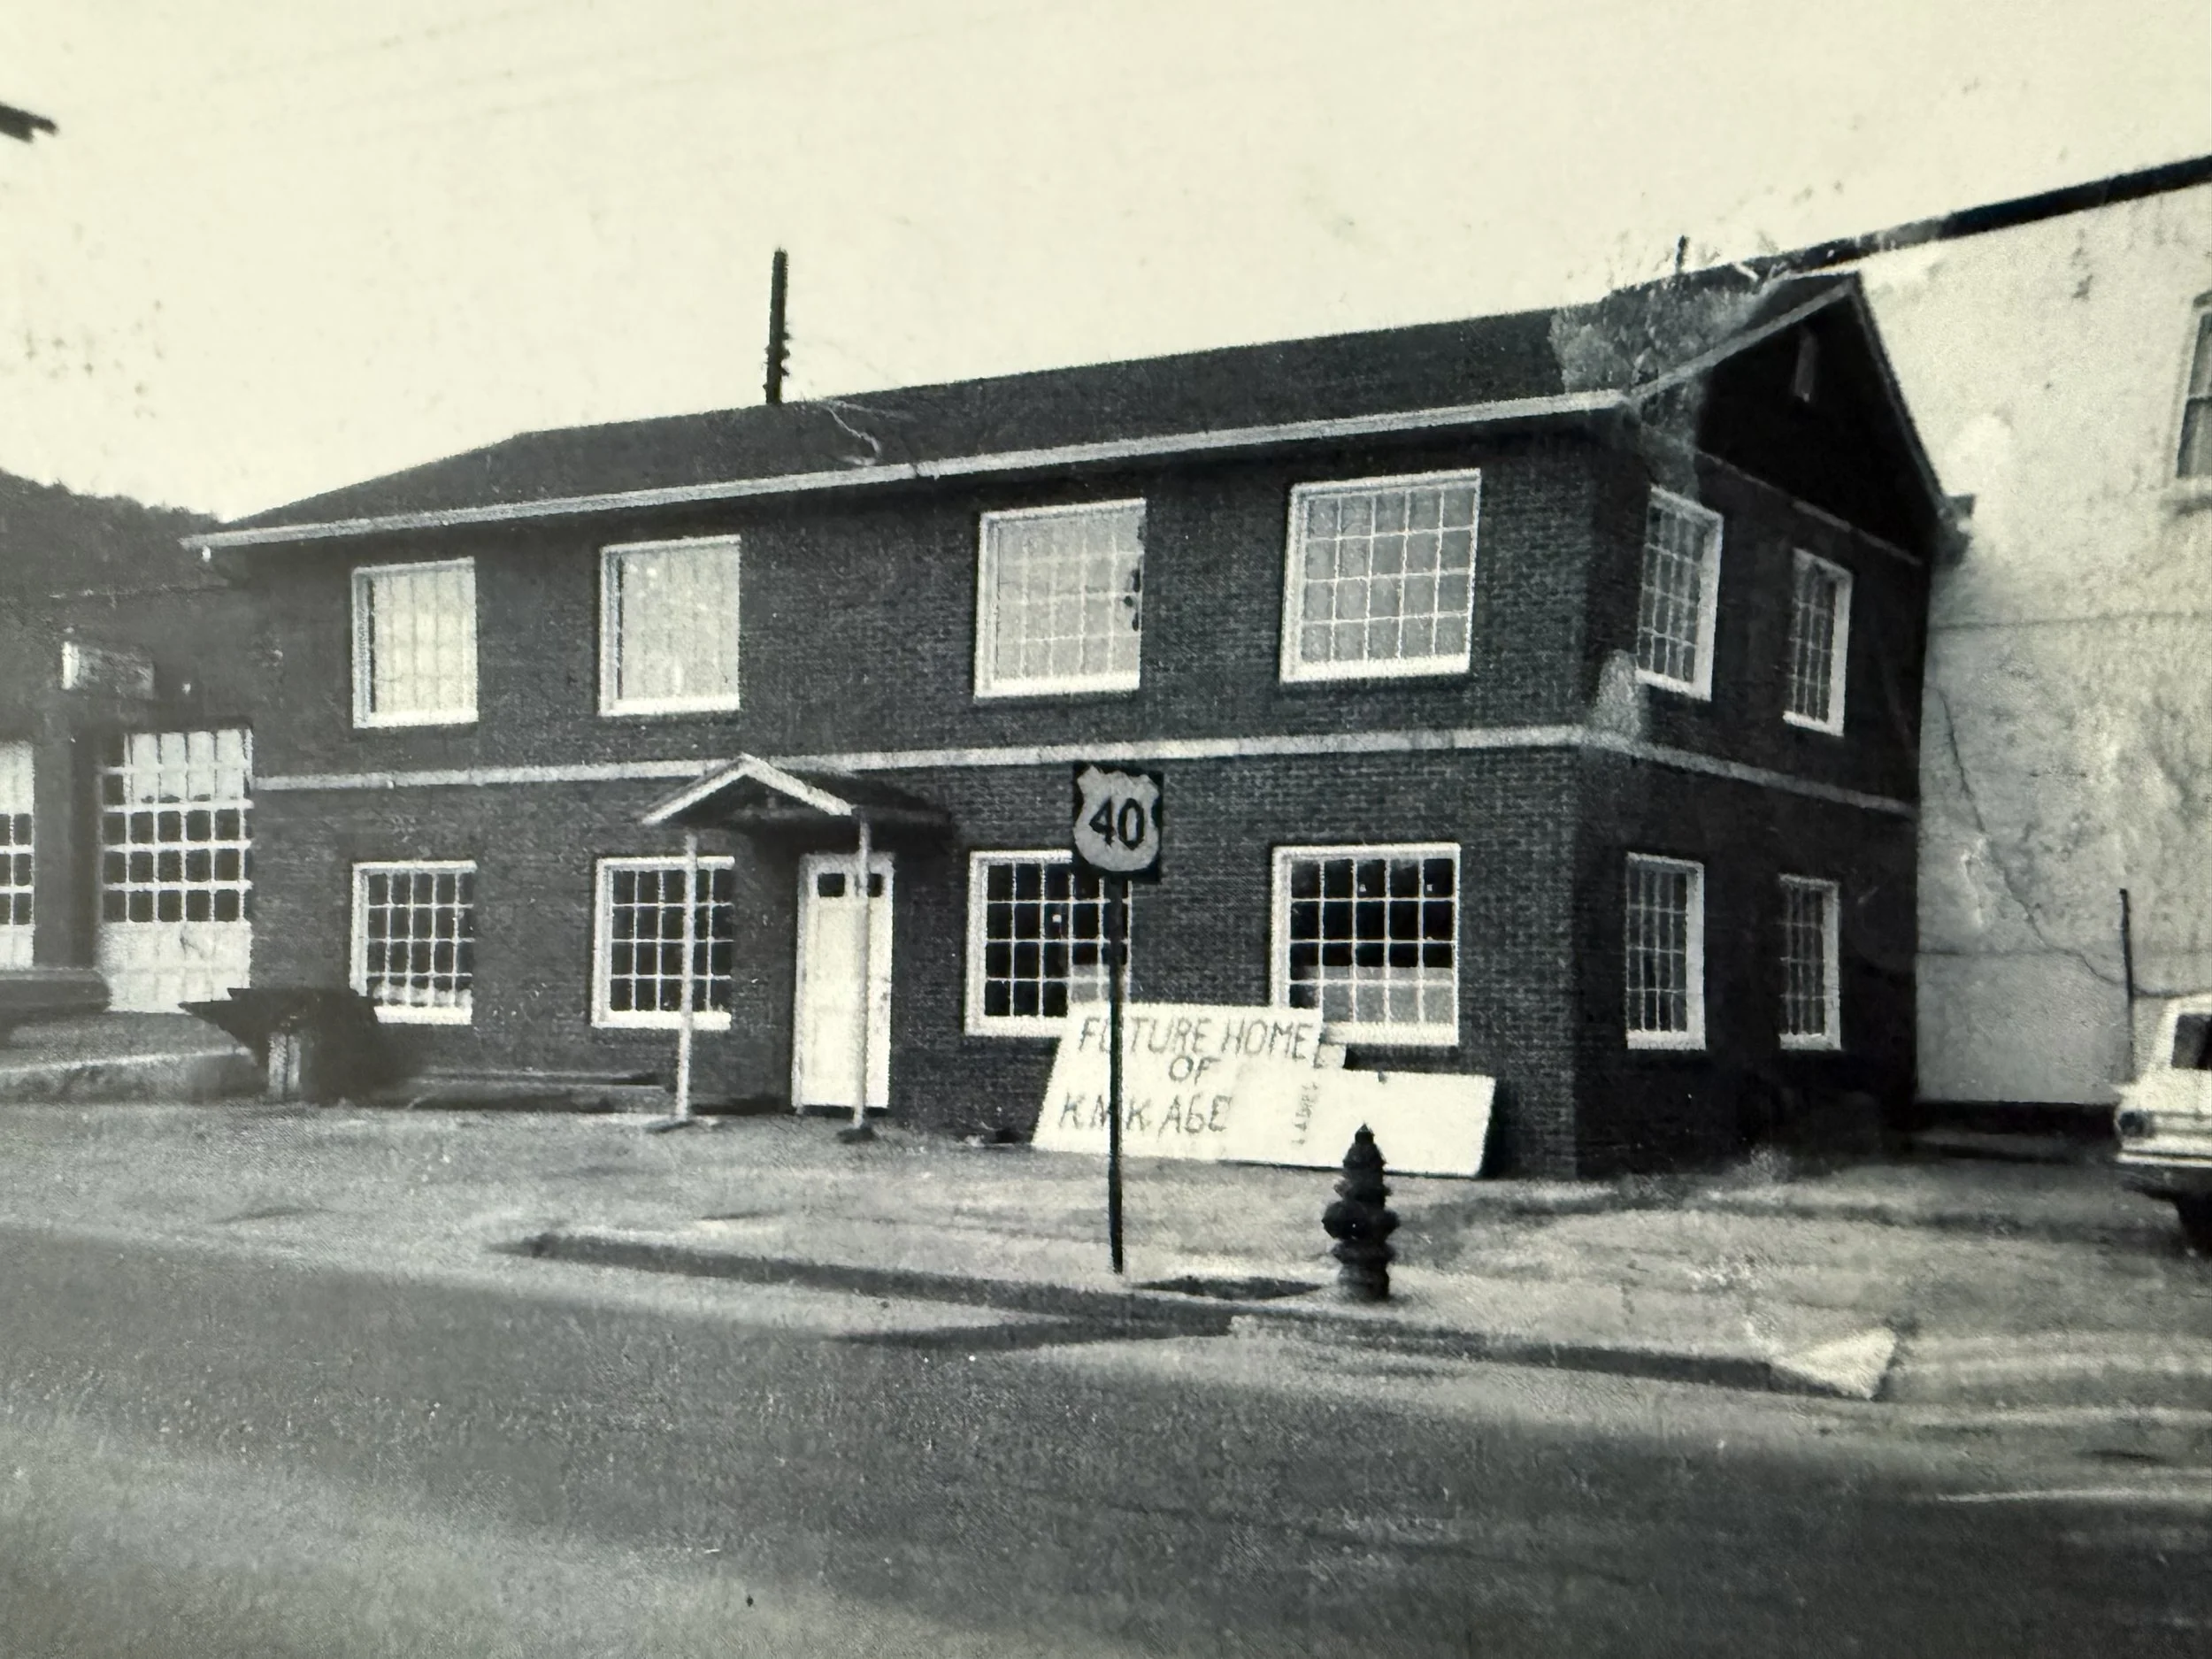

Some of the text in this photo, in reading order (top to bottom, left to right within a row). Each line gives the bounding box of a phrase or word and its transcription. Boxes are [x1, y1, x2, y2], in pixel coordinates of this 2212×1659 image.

[1088, 795, 1145, 850] 40
[1221, 1016, 1314, 1060] HOME
[1168, 1054, 1222, 1085] OF
